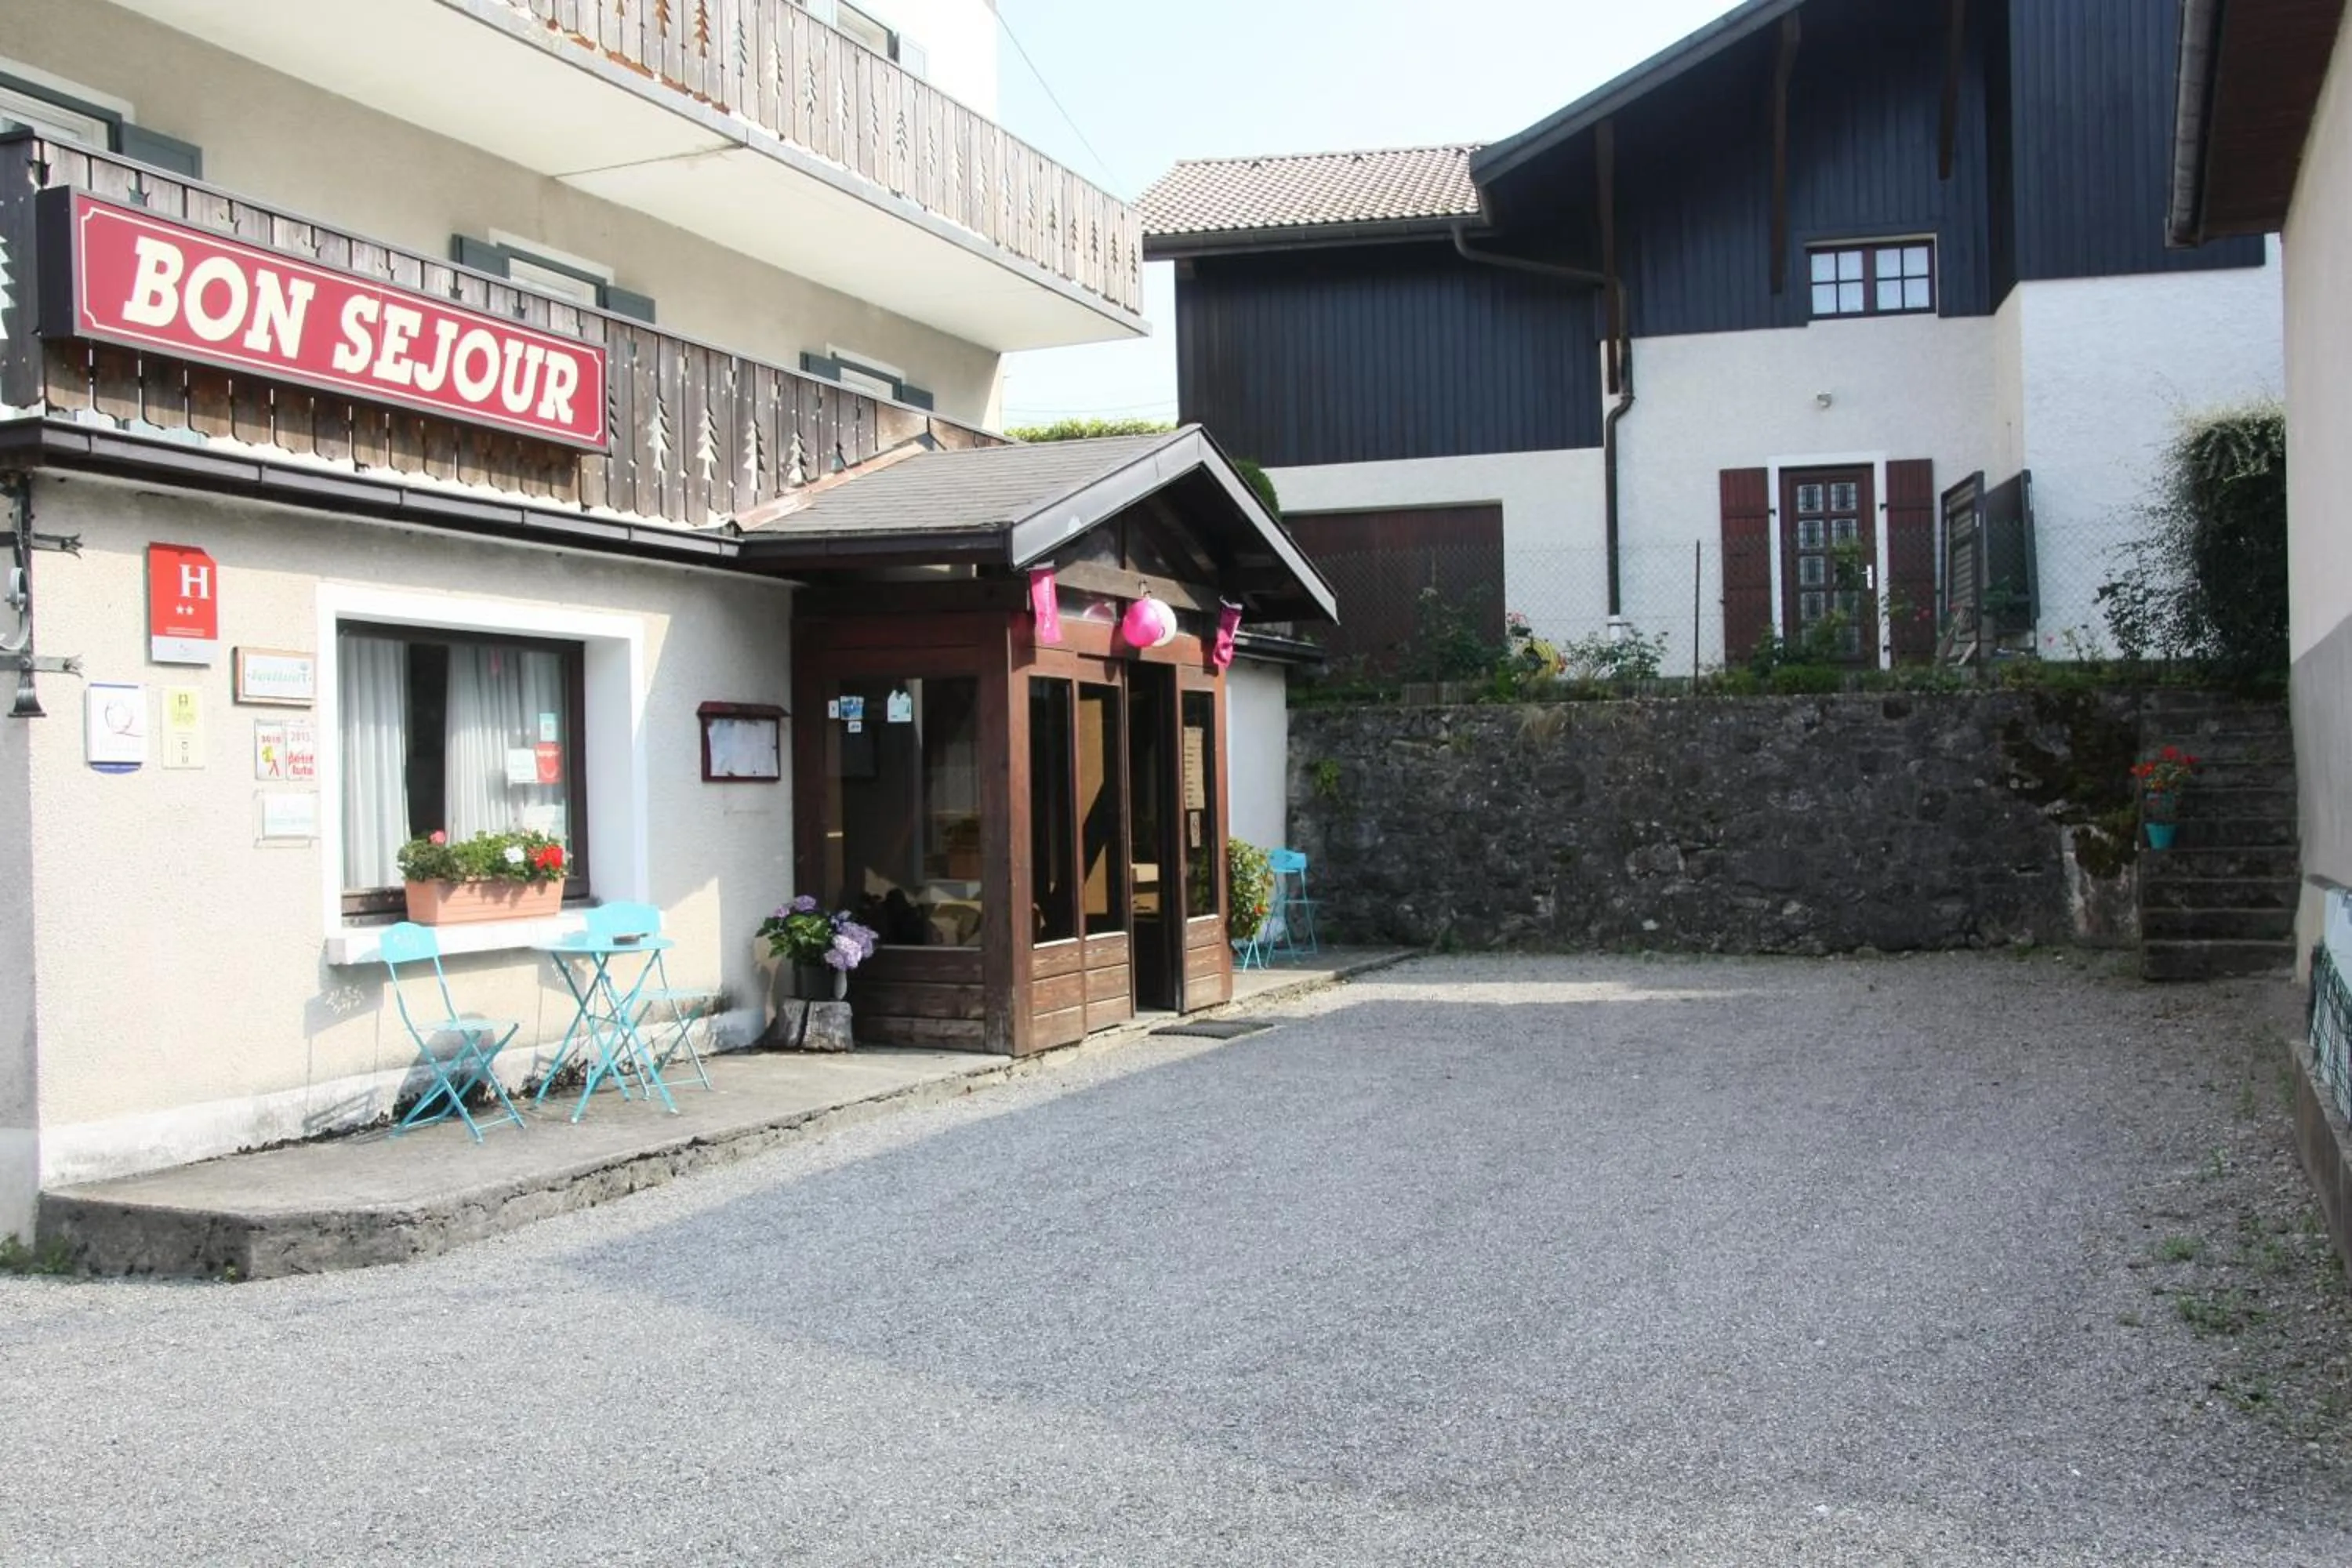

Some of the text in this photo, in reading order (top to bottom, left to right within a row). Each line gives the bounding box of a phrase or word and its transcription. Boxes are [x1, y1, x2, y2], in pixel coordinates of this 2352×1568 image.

[122, 236, 580, 424] BON SEJOUR
[179, 564, 210, 599] H
